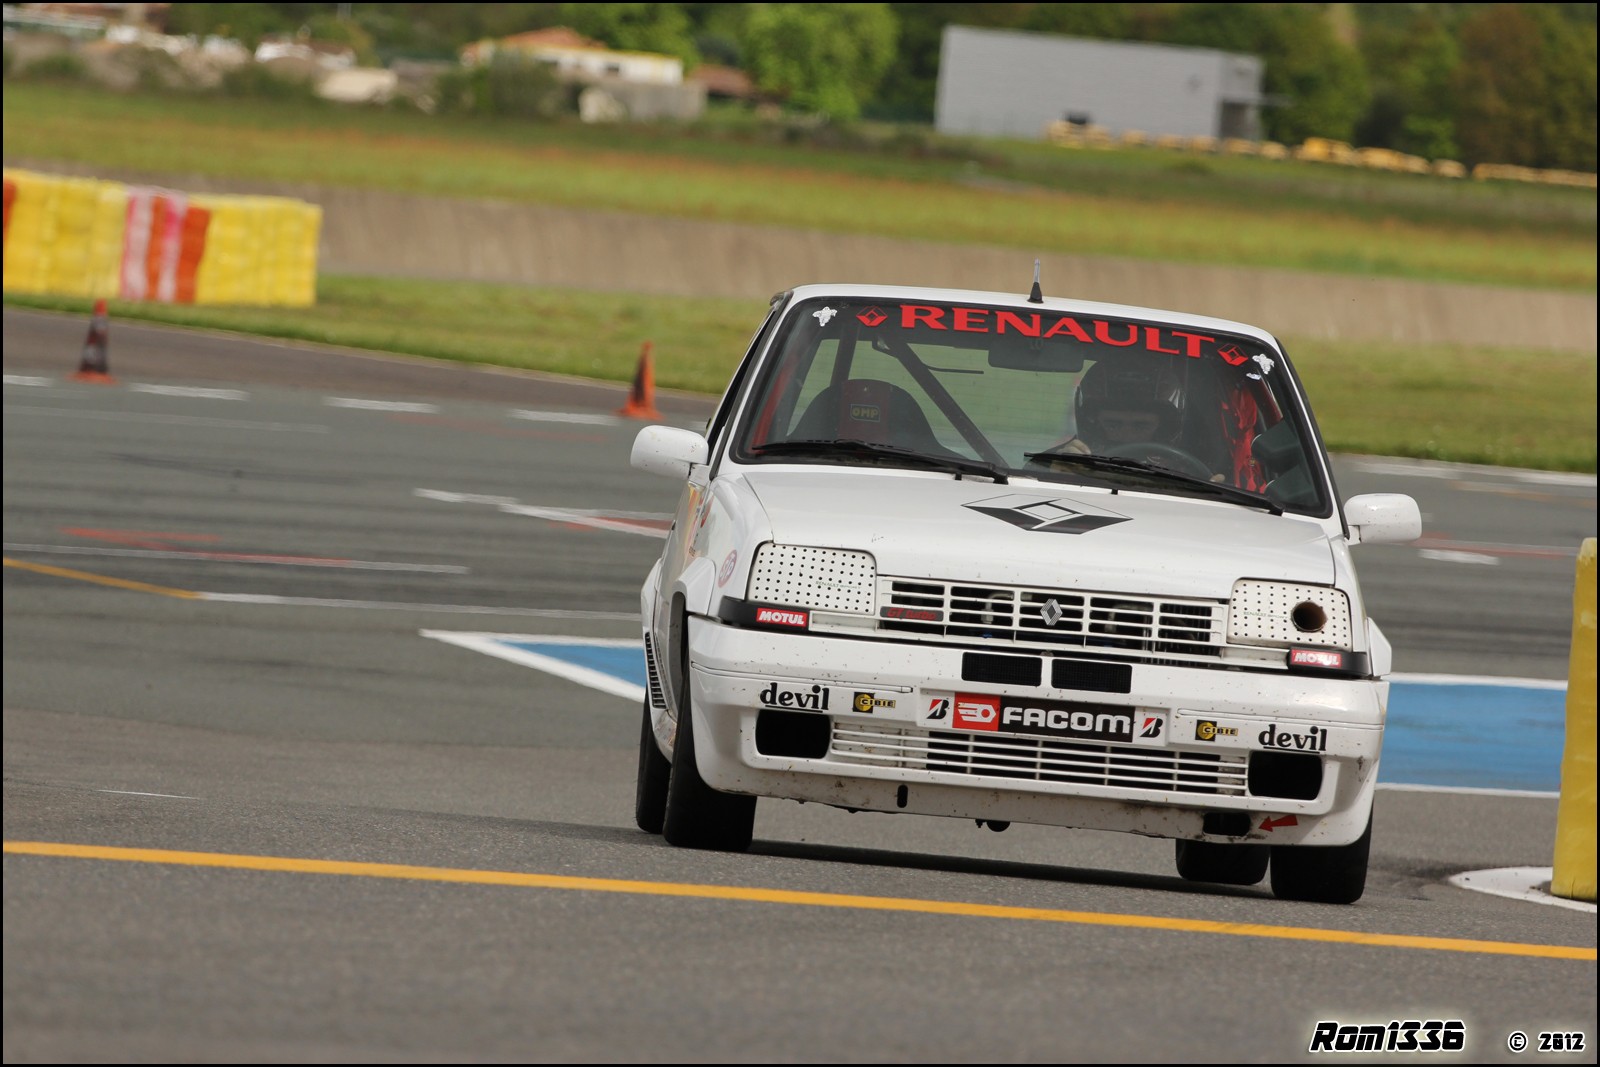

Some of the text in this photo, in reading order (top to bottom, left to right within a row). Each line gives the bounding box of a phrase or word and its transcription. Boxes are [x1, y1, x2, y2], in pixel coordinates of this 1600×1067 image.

[900, 304, 1215, 359] RENAULT
[758, 610, 805, 625] MOTUL
[1294, 651, 1339, 666] MOTUL
[759, 682, 830, 711] devil
[1002, 706, 1131, 734] FACOM
[1258, 723, 1328, 751] devil
